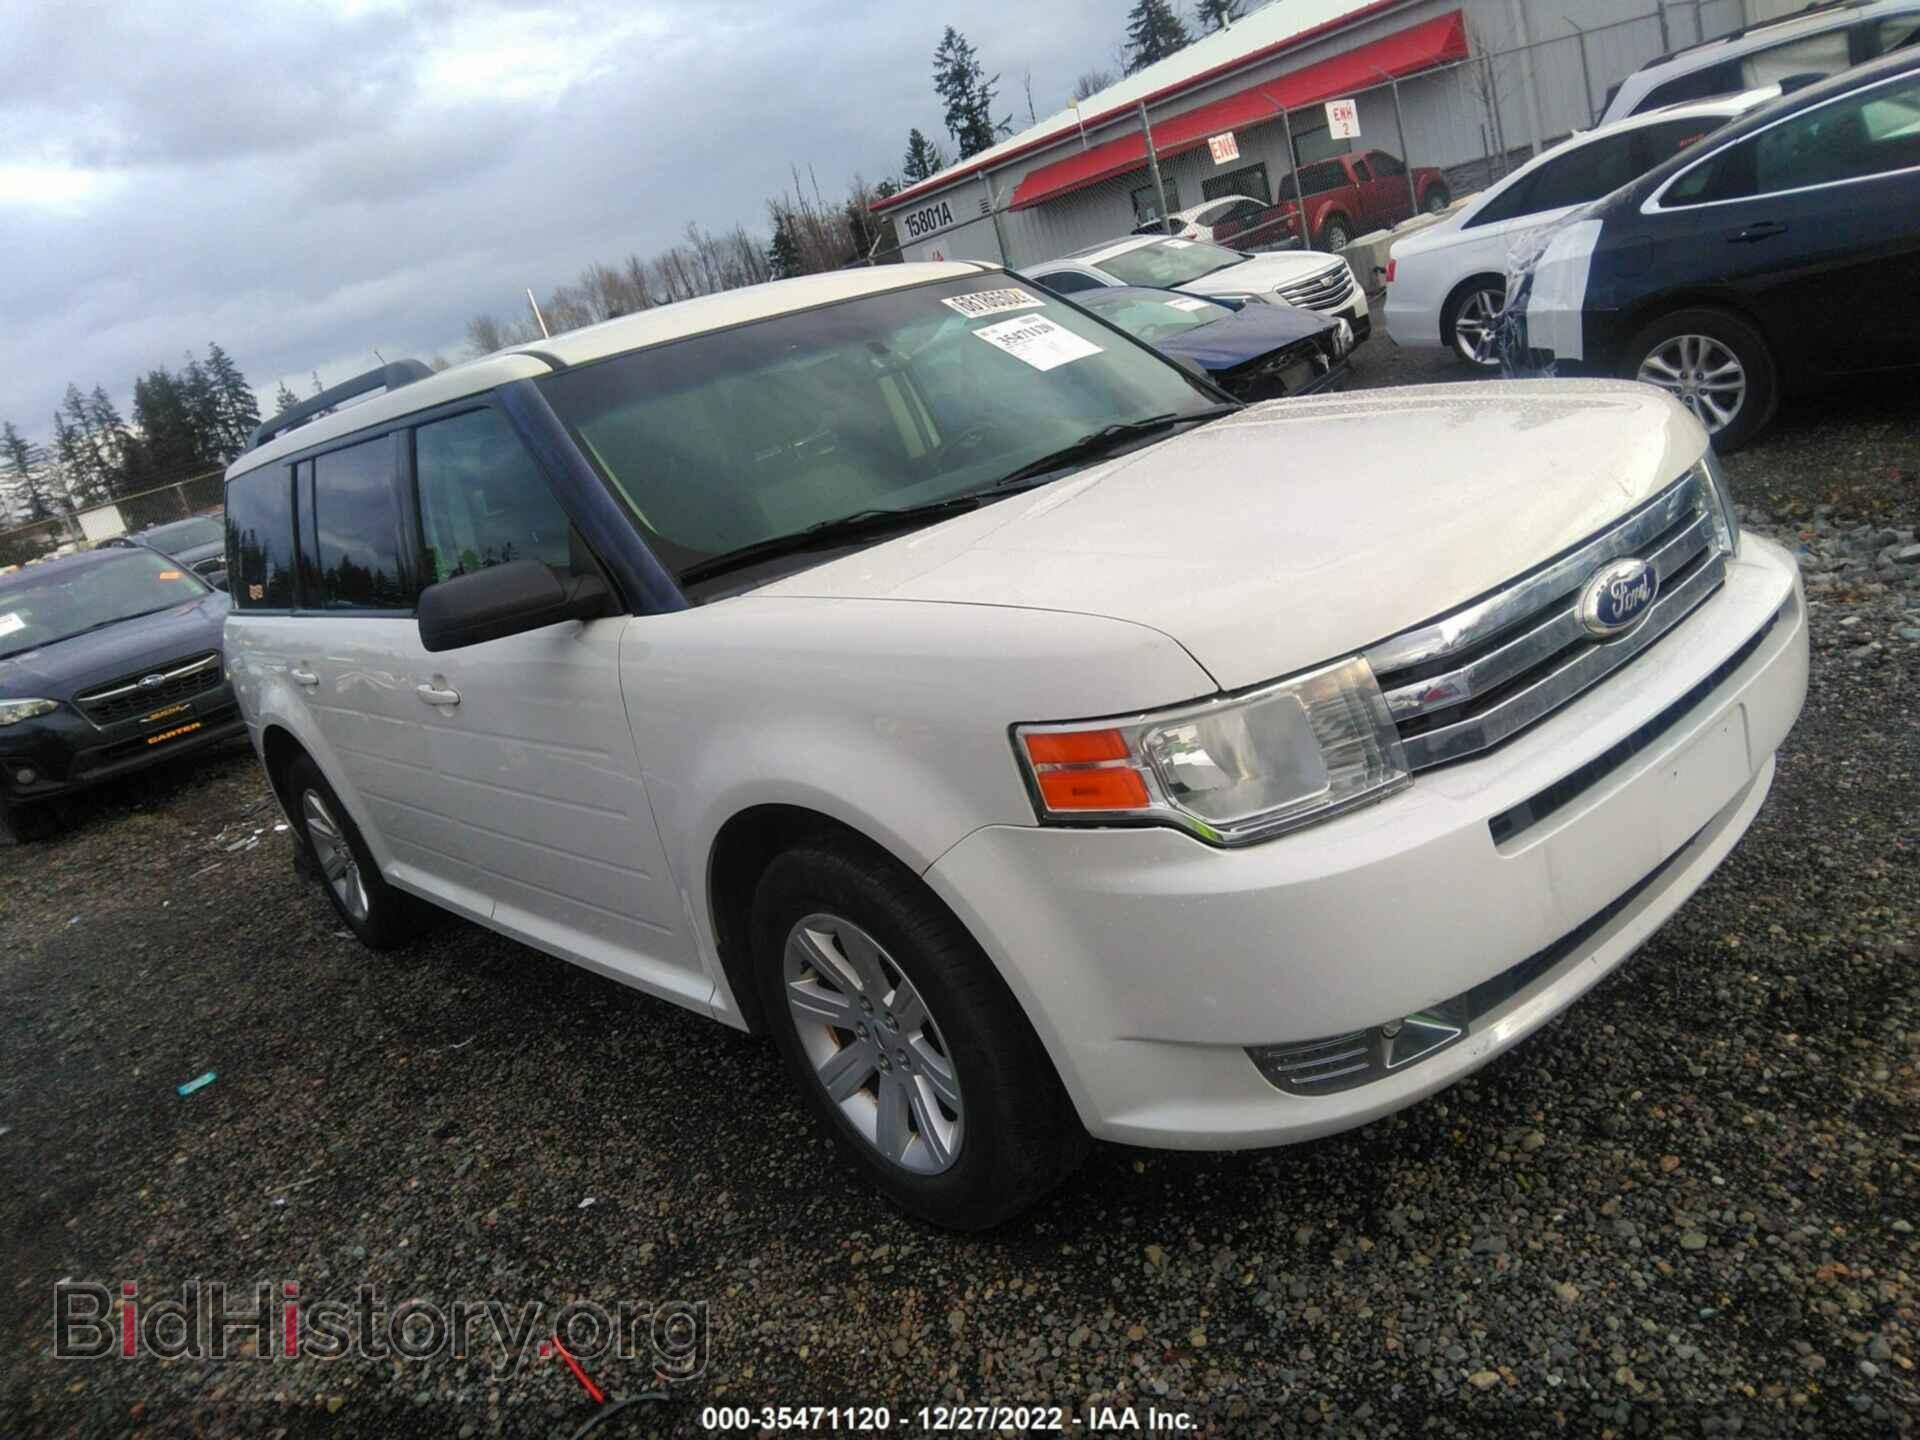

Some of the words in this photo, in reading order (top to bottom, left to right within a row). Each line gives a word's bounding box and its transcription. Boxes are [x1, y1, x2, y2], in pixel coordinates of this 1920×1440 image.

[1333, 107, 1353, 122] ENH
[1342, 123, 1350, 136] 2
[1211, 137, 1239, 161] ENH
[904, 201, 953, 238] 15801A
[1610, 573, 1651, 619] Ford
